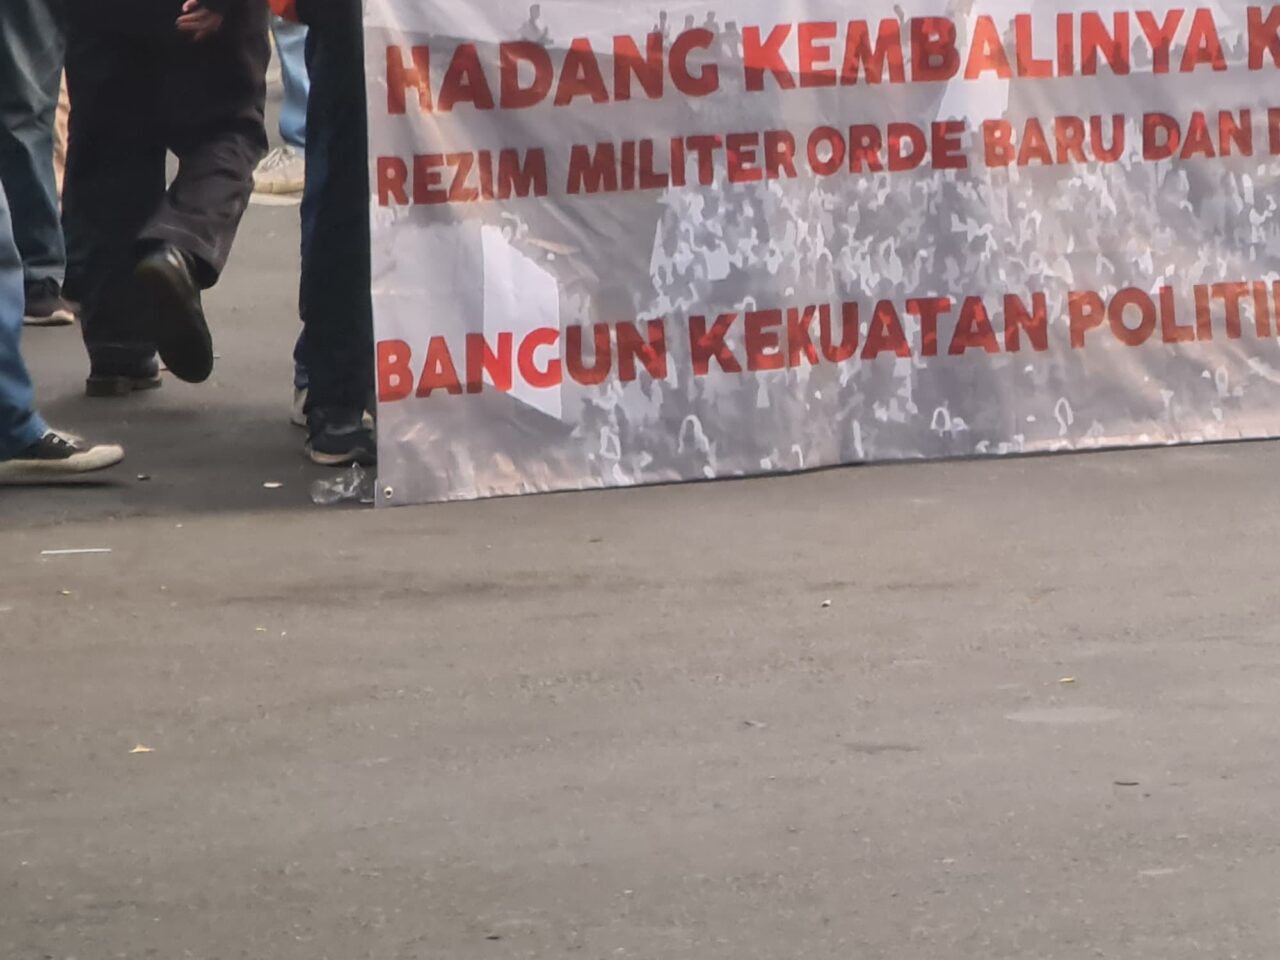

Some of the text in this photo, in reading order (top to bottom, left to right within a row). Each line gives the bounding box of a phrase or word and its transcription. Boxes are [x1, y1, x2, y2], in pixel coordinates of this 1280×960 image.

[386, 28, 719, 114] HADANG
[742, 7, 1227, 91] KEMBALINYA
[376, 148, 548, 207] REZIM
[567, 130, 797, 195] MILITER
[806, 121, 968, 177] ORDE
[983, 113, 1126, 168] BARU
[1142, 108, 1254, 162] DAN
[376, 318, 668, 403] BANGUN
[687, 291, 1049, 377] KEKUATAN
